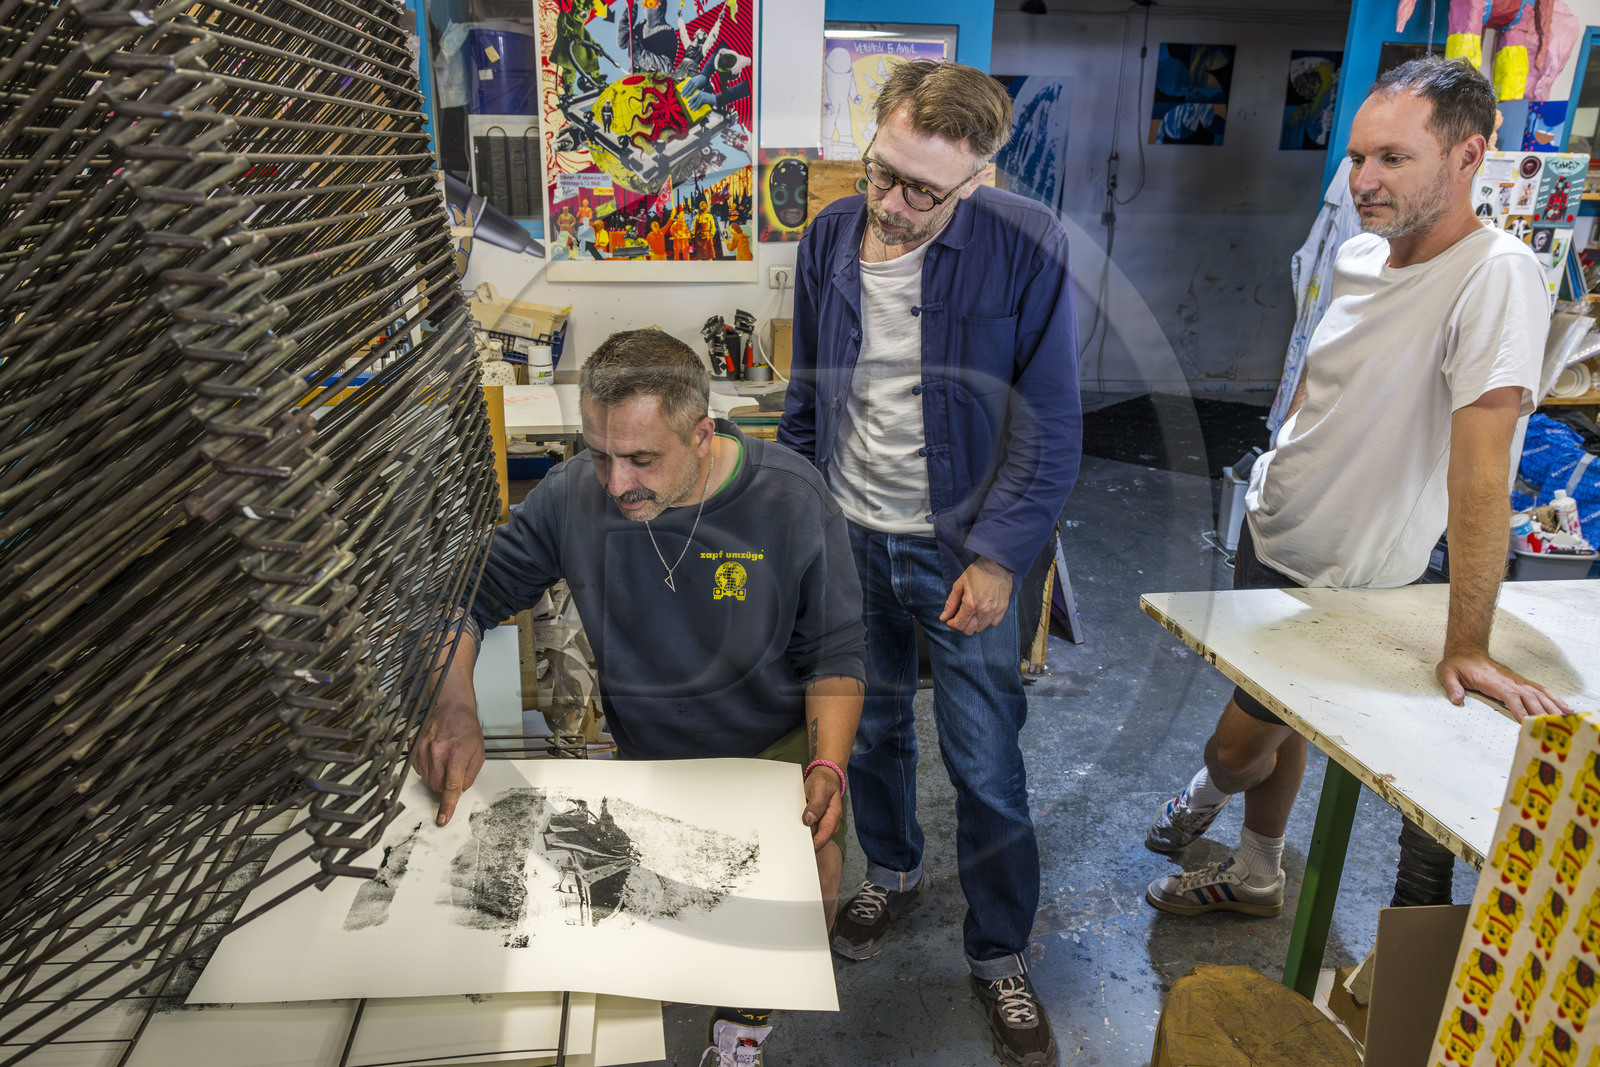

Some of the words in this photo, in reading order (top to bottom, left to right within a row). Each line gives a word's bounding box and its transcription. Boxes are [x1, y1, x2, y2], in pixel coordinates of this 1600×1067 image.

[887, 43, 894, 54] 5
[700, 550, 724, 561] zapf
[725, 550, 764, 562] umzüge
